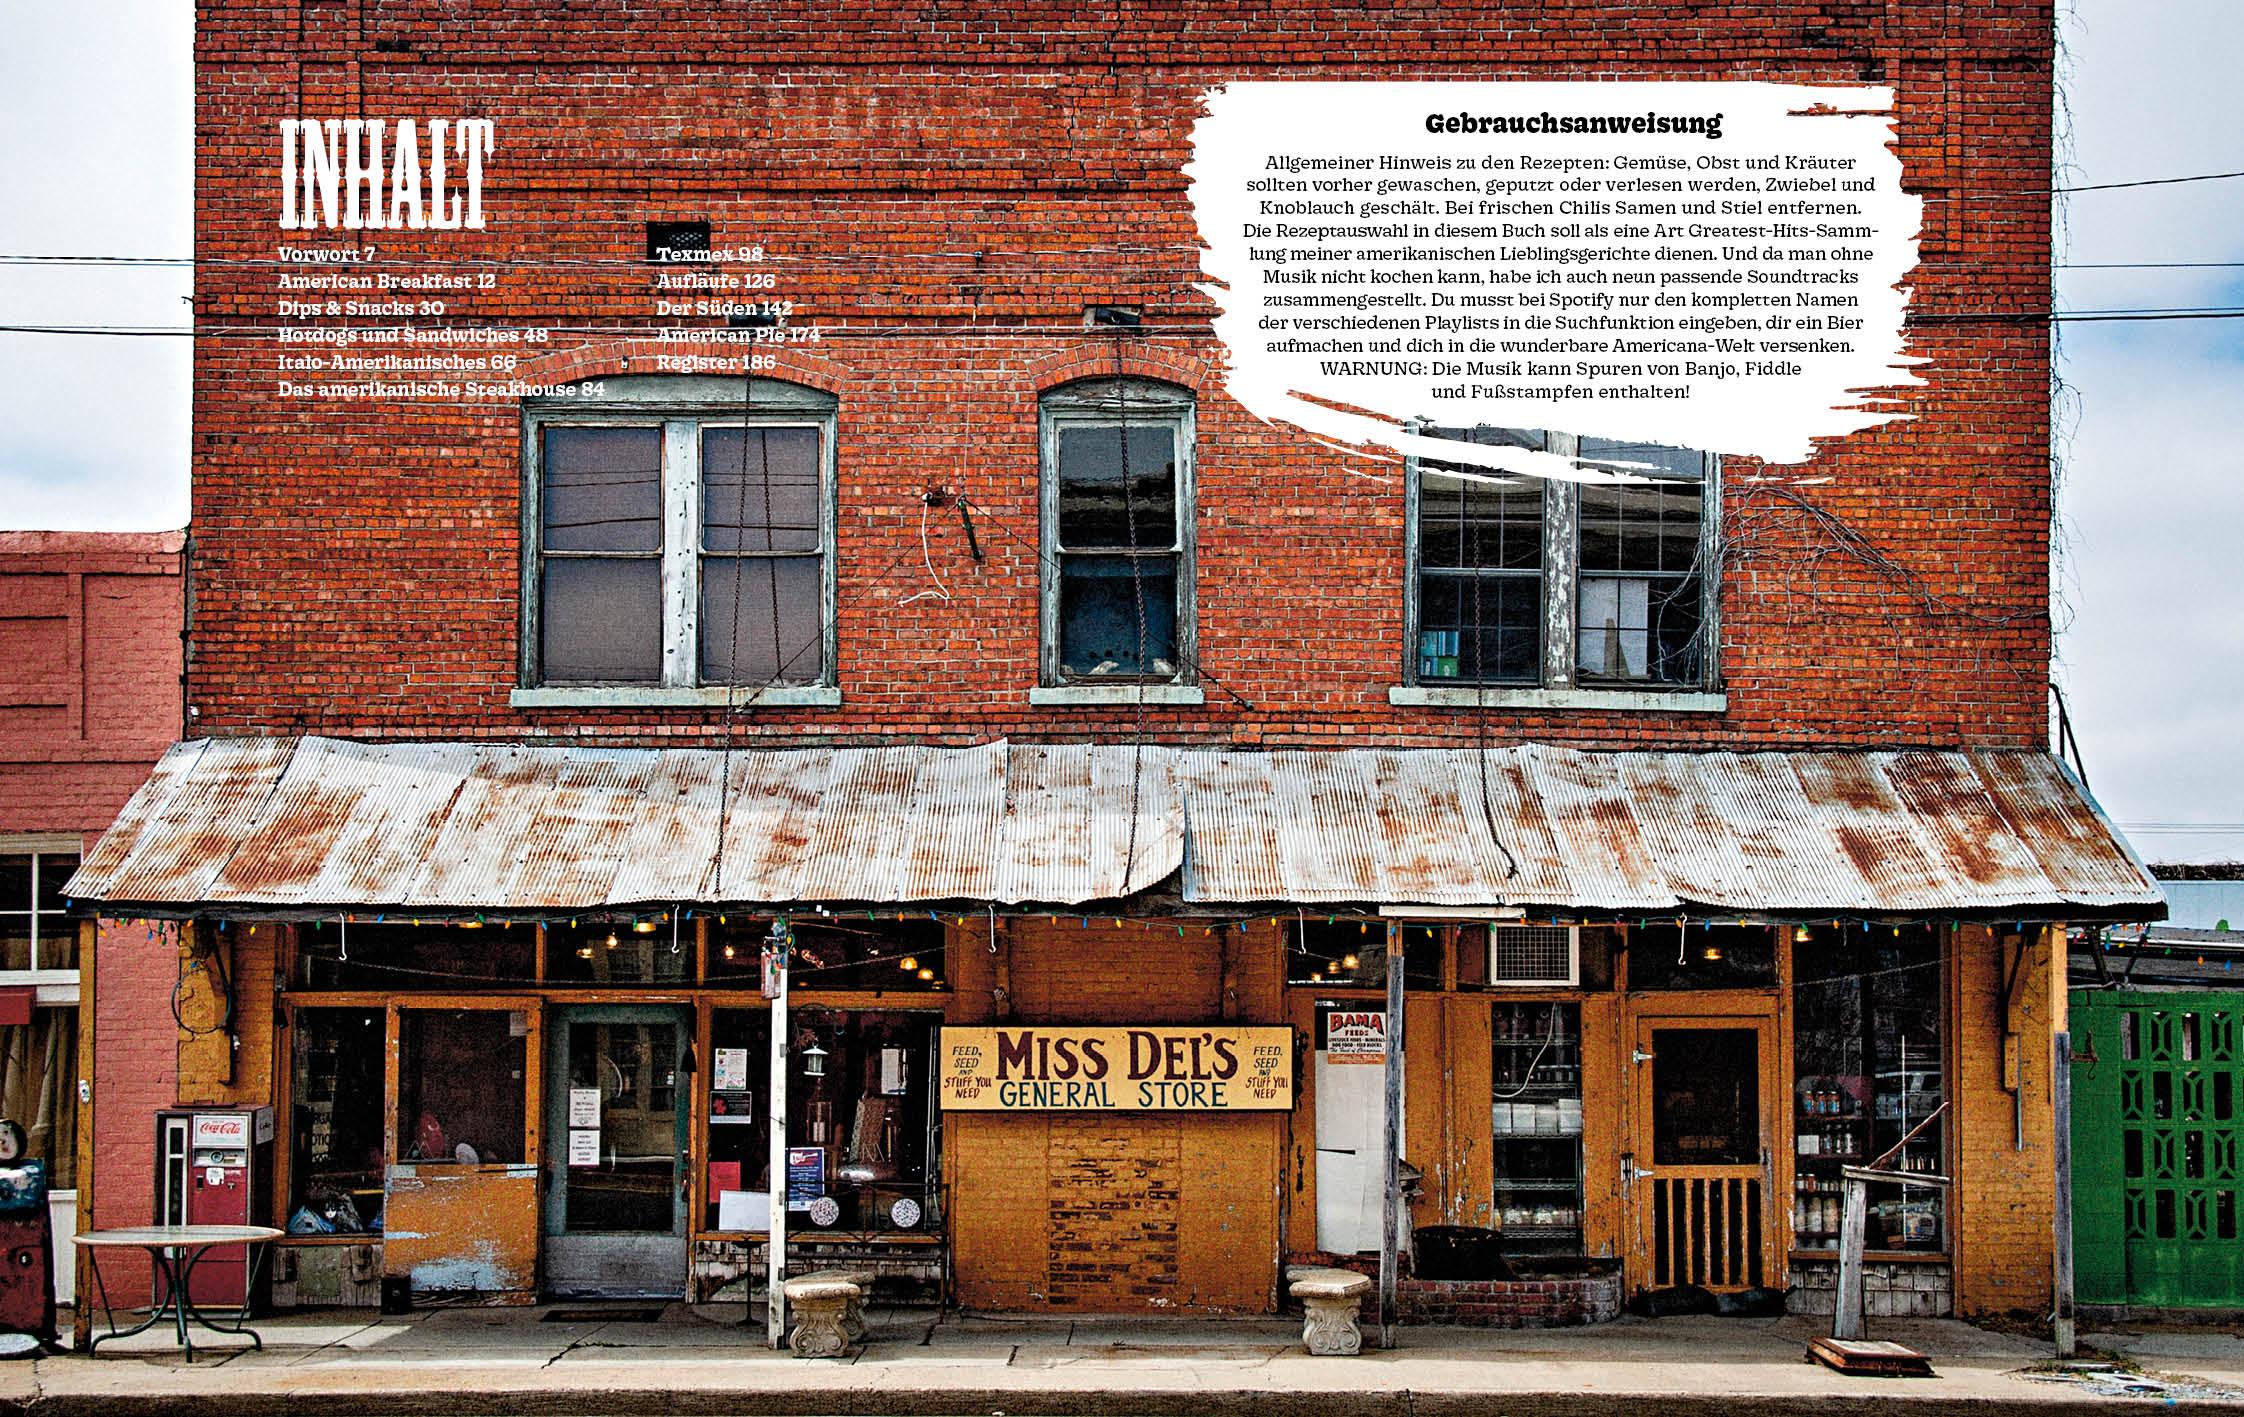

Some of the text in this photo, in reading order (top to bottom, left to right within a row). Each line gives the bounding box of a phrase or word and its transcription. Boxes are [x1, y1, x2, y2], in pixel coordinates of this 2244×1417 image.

[1330, 1014, 1385, 1036] BAMA
[995, 1031, 1239, 1081] MISS DEL'S
[953, 1057, 979, 1069] SEED
[1253, 1057, 1279, 1069] SEED
[944, 1076, 992, 1089] STUFF YOU
[1245, 1076, 1289, 1089] STUFF YOU
[955, 1087, 980, 1099] NEED
[999, 1081, 1228, 1108] GENERAL STORE
[1253, 1088, 1277, 1100] NEED
